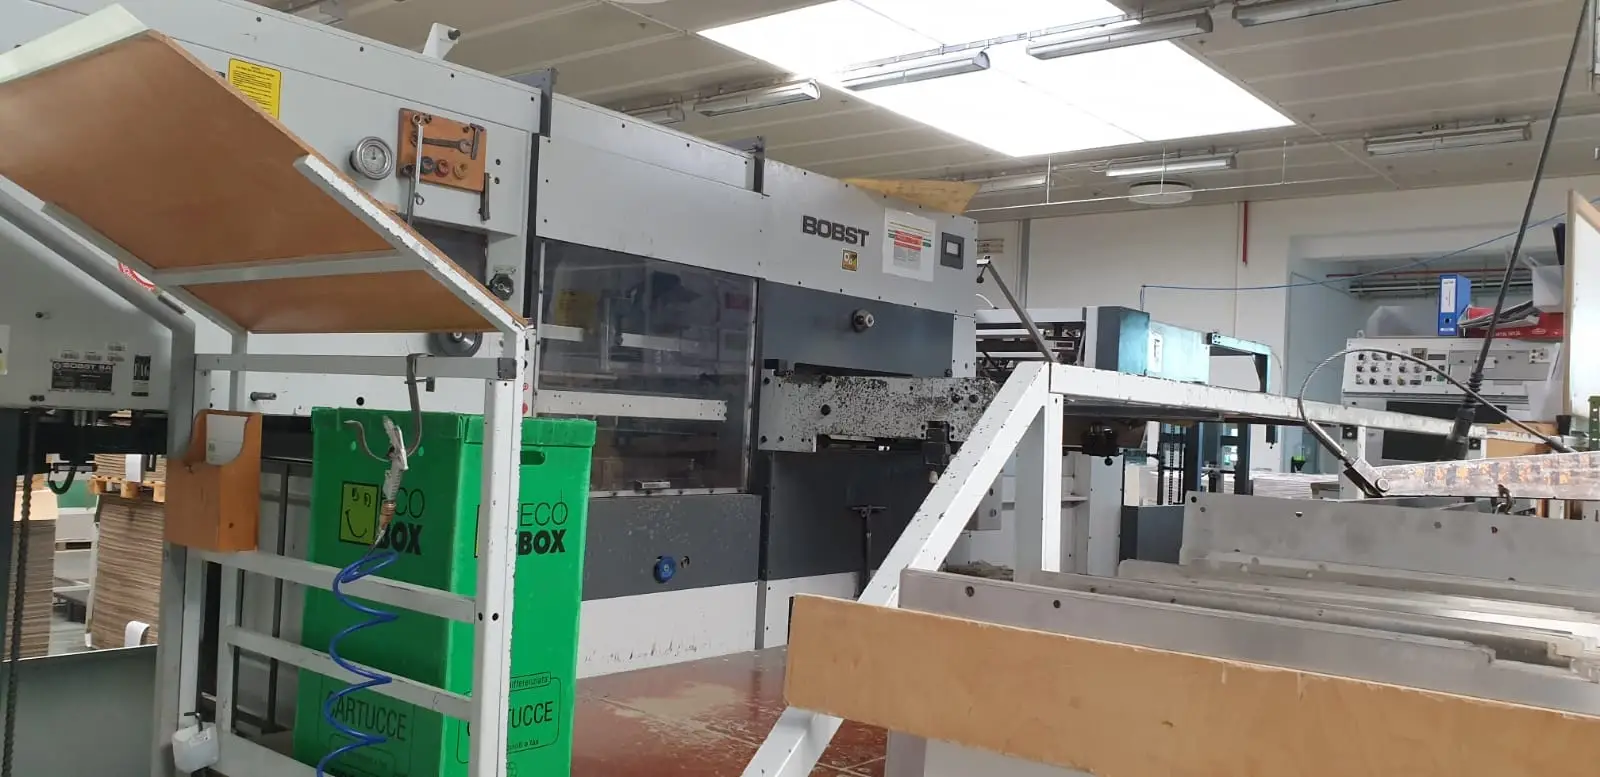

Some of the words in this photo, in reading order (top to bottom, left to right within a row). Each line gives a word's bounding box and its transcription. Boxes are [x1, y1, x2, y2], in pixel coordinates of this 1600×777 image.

[802, 215, 869, 247] BOBST
[380, 486, 425, 518] CO
[520, 502, 568, 526] ECO
[518, 529, 567, 555] BOX
